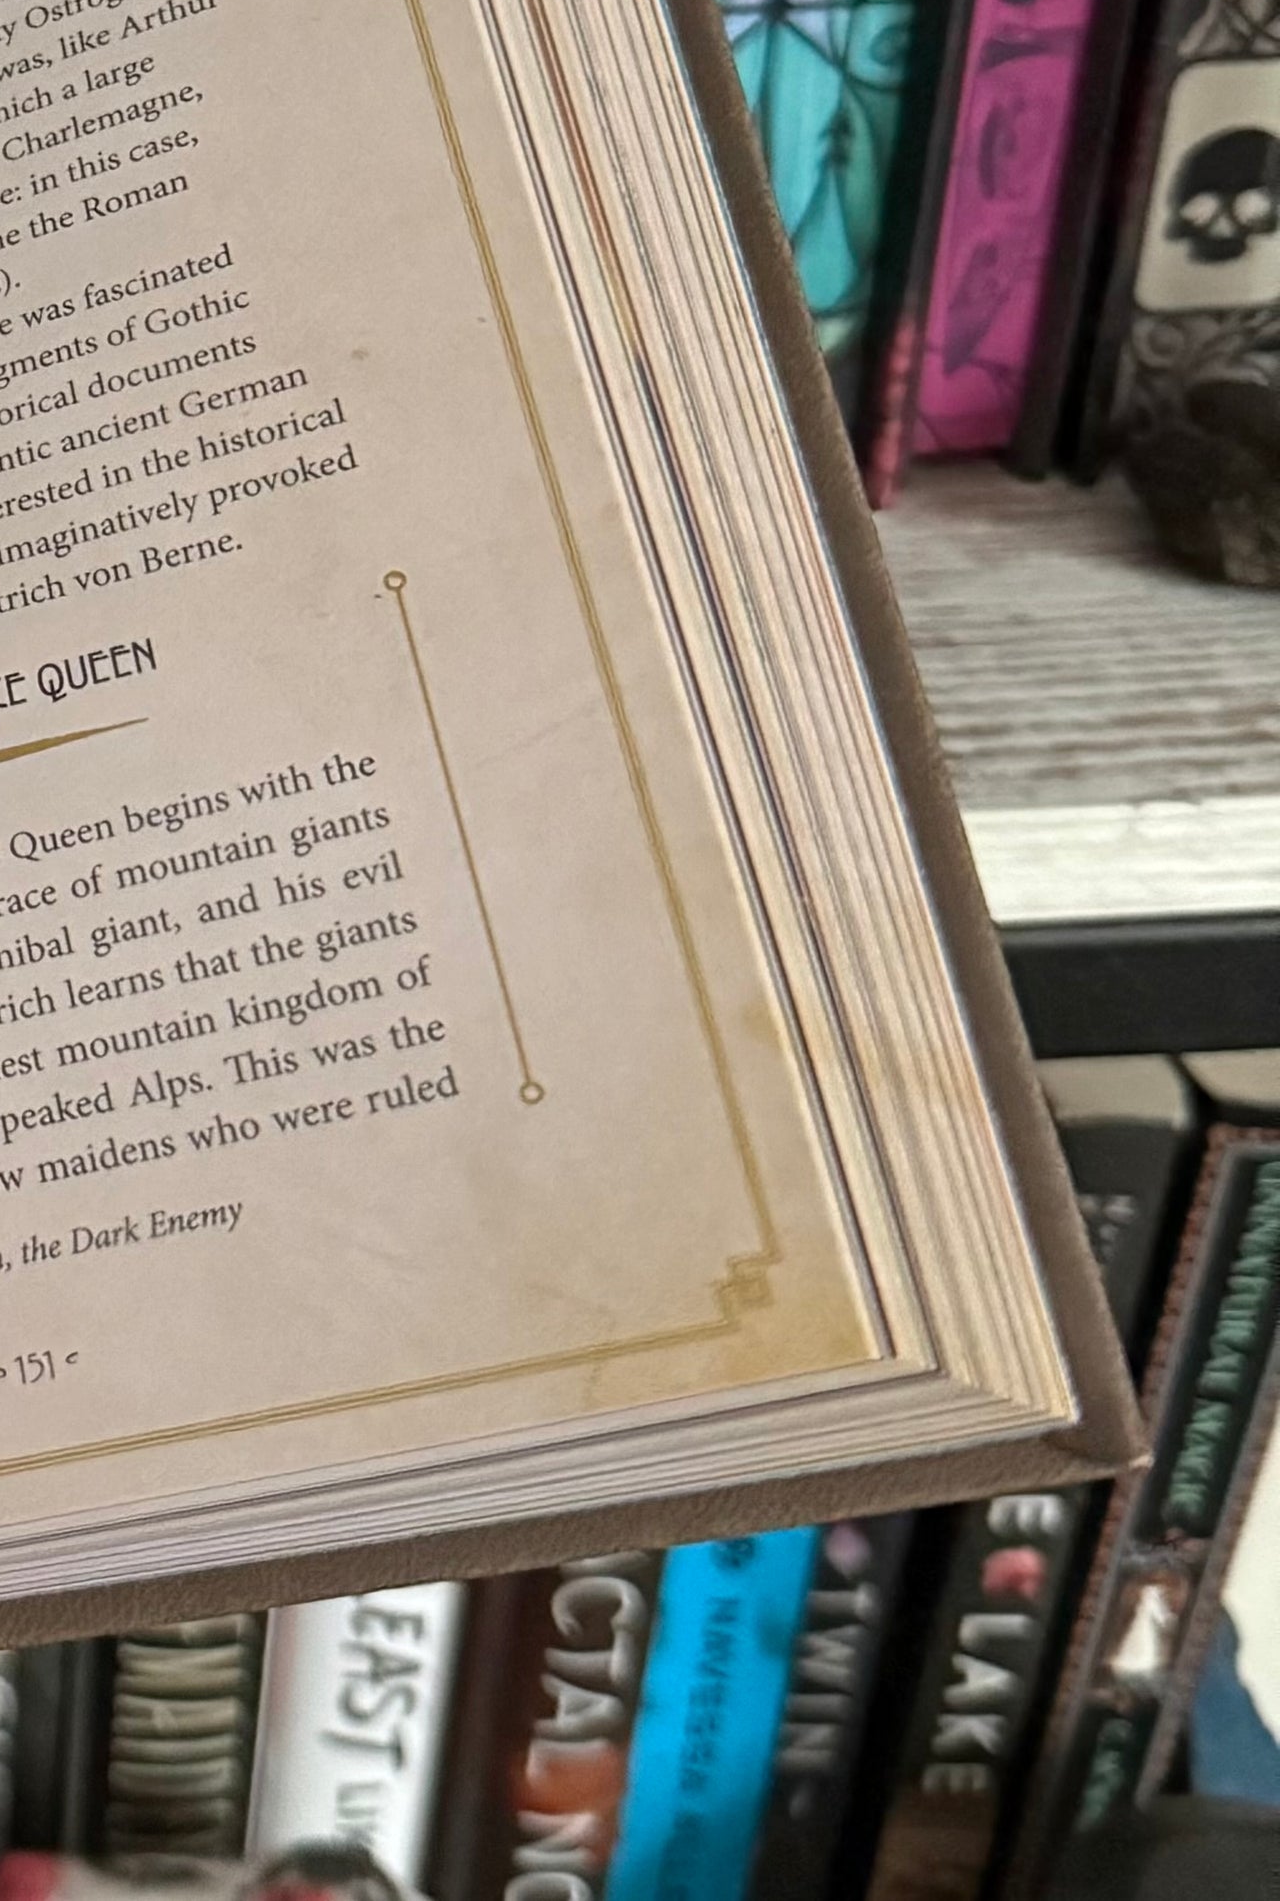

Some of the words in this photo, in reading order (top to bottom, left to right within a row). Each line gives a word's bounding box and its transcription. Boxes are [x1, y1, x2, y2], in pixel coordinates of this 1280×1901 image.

[62, 84, 77, 100] a
[84, 57, 154, 92] large
[20, 299, 75, 328] was
[84, 242, 233, 309] fascinated
[88, 336, 256, 398] documents
[73, 563, 132, 590] von
[140, 535, 242, 574] Berne.
[37, 638, 156, 703] QUEEN
[10, 820, 115, 861] Queen
[122, 792, 230, 833] begins
[238, 765, 313, 804] with
[323, 754, 376, 786] the
[71, 864, 102, 898] of
[116, 835, 276, 889] mountain
[291, 808, 390, 857] giants
[91, 909, 181, 957] giant,
[198, 883, 260, 923] and
[274, 876, 326, 906] his
[343, 850, 403, 889] evil
[64, 969, 164, 1008] learns
[175, 949, 240, 983] that
[251, 935, 304, 966] the
[316, 912, 417, 962] giants
[57, 1014, 217, 1066] mountain
[227, 977, 383, 1028] kingdom
[397, 954, 431, 990] of
[131, 1070, 212, 1108] Alps.
[223, 1050, 299, 1084] This
[312, 1036, 377, 1066] was
[389, 1017, 445, 1050] the
[38, 1136, 176, 1183] maidens
[187, 1114, 260, 1150] who
[272, 1099, 353, 1131] were
[367, 1065, 459, 1114] ruled
[22, 1235, 61, 1264] the
[72, 1216, 139, 1254] Dark
[151, 1203, 242, 1238] Enemy
[13, 1351, 57, 1384] 151
[922, 1611, 1035, 1793] LAKE
